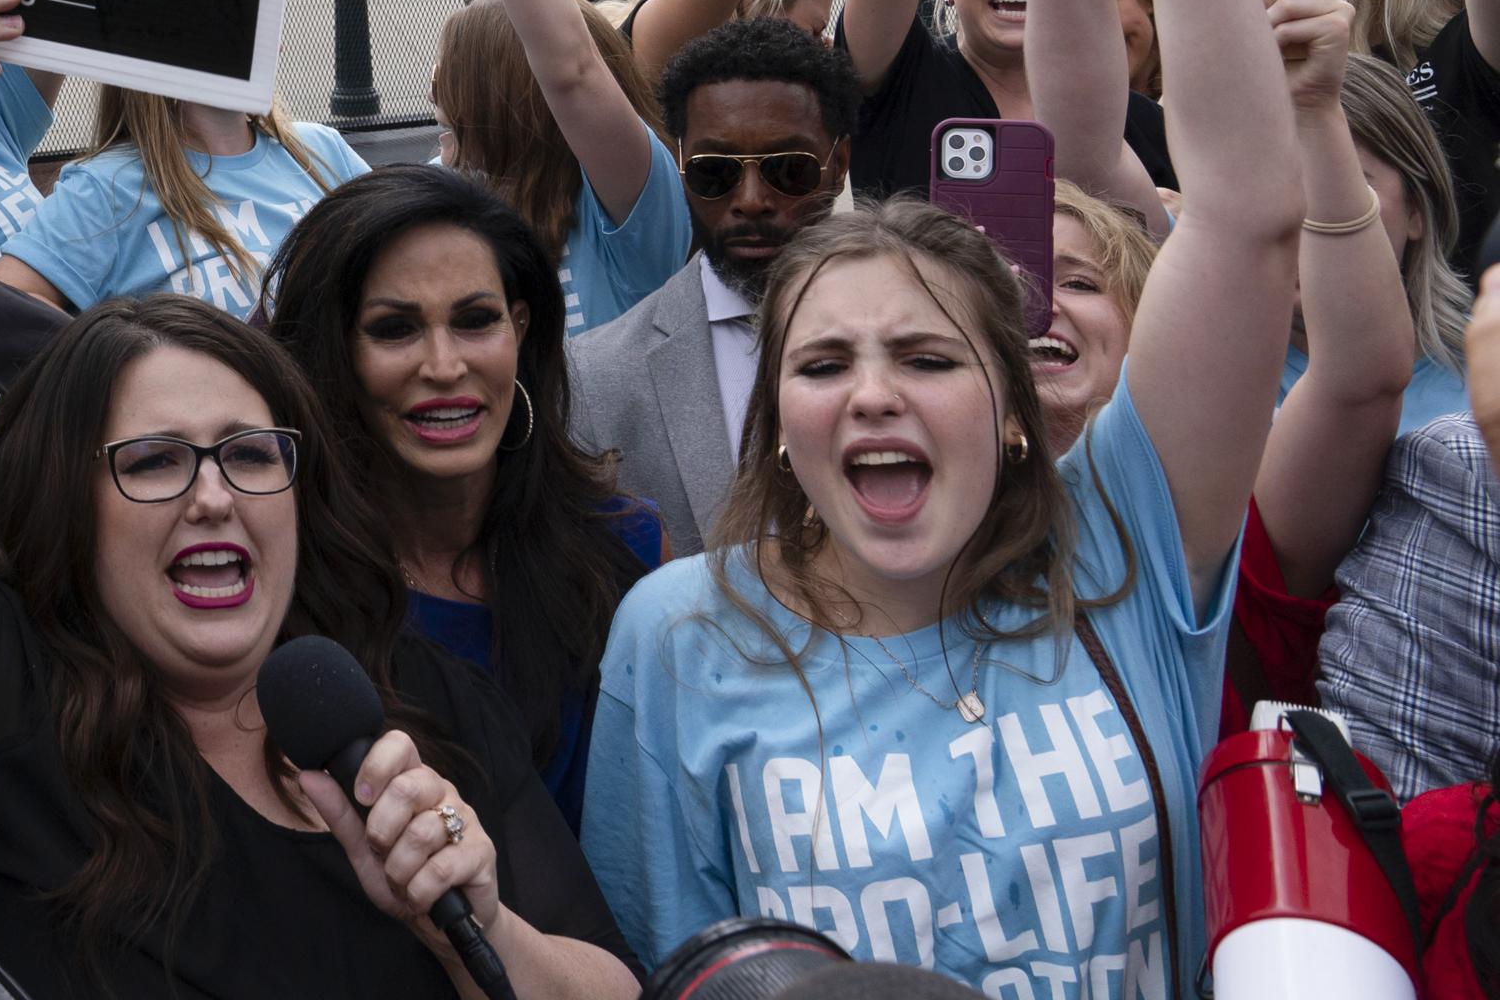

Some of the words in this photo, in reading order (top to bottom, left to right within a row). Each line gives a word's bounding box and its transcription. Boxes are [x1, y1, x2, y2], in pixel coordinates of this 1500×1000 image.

[724, 764, 760, 873] I
[763, 754, 933, 872] AM
[949, 689, 1154, 838] THE
